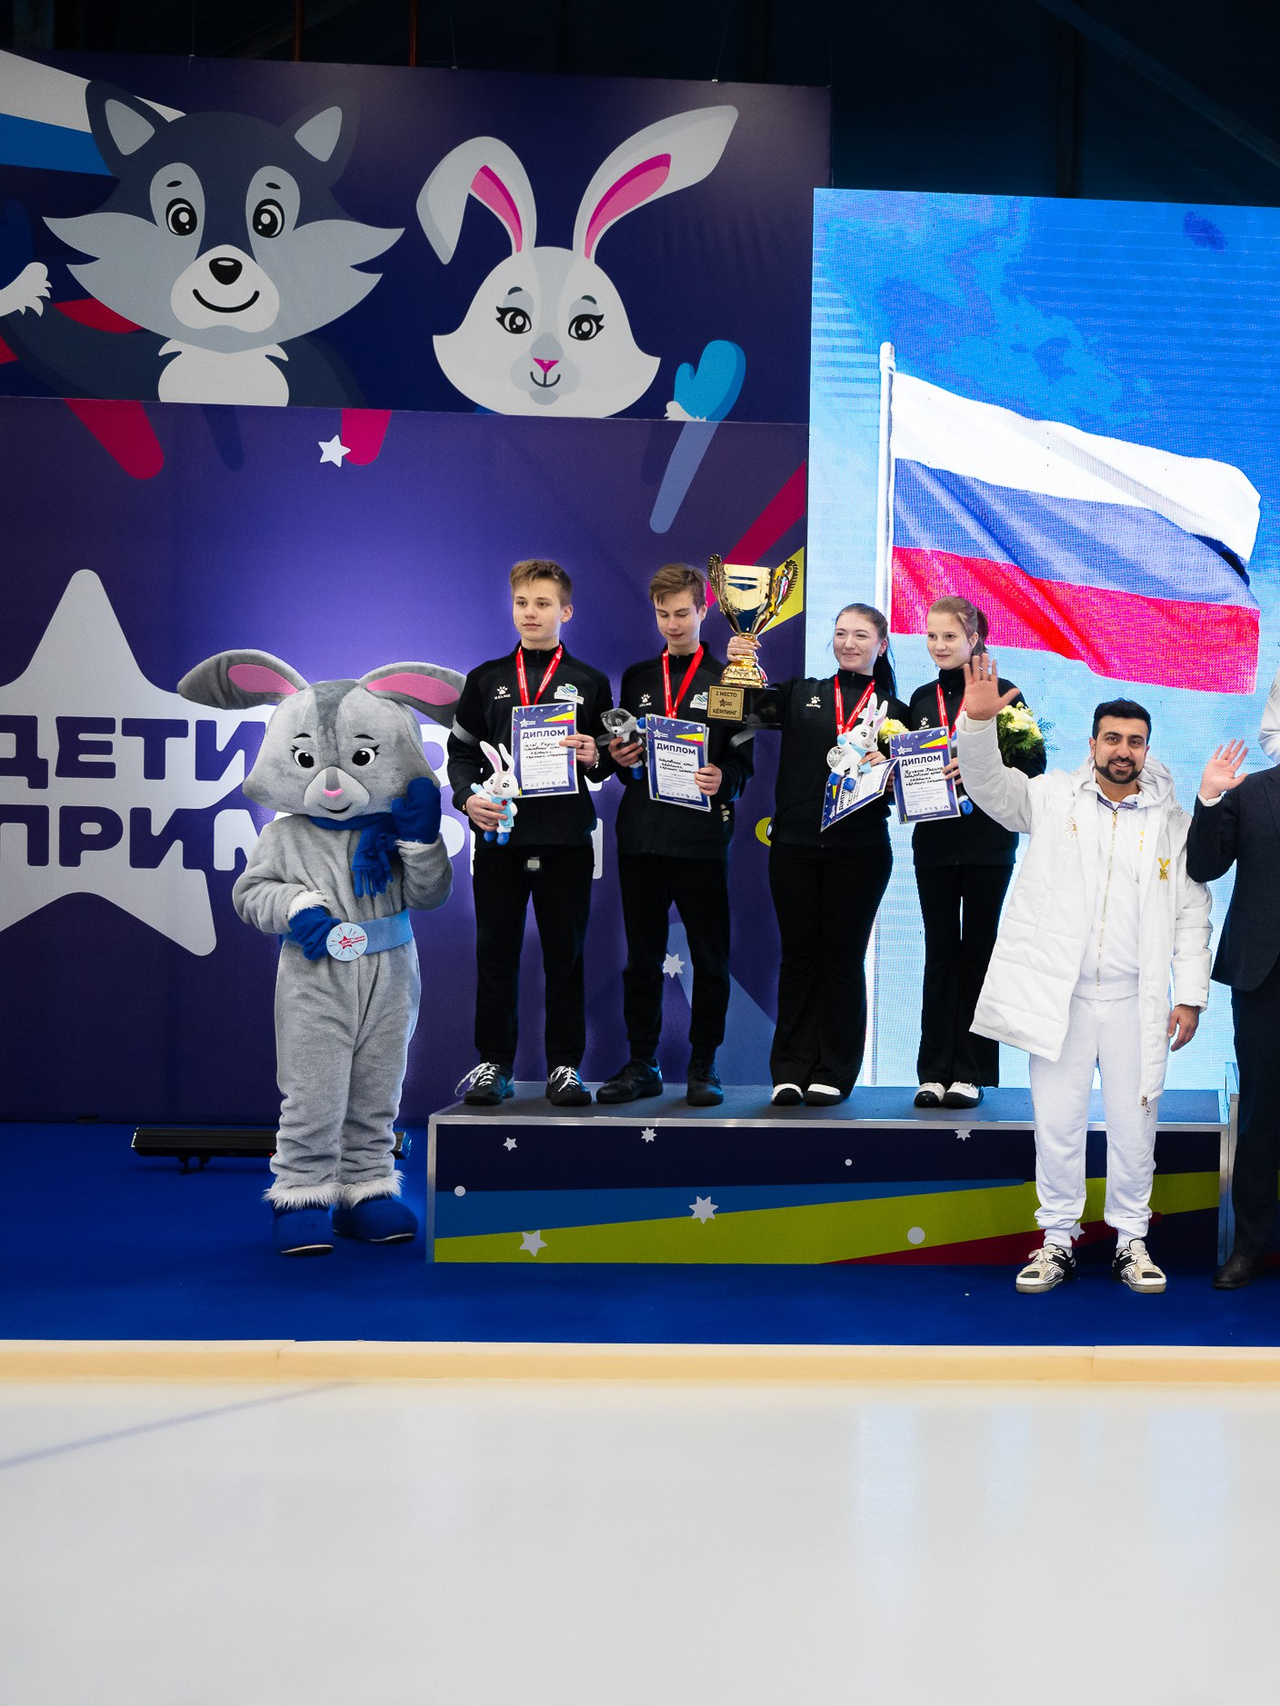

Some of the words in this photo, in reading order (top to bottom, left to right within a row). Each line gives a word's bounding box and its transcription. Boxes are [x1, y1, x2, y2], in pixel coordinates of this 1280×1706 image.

[522, 729, 565, 740] ДИПЛОМ
[656, 743, 696, 755] ДИПЛОМ
[901, 754, 941, 768] ДИПЛОМ
